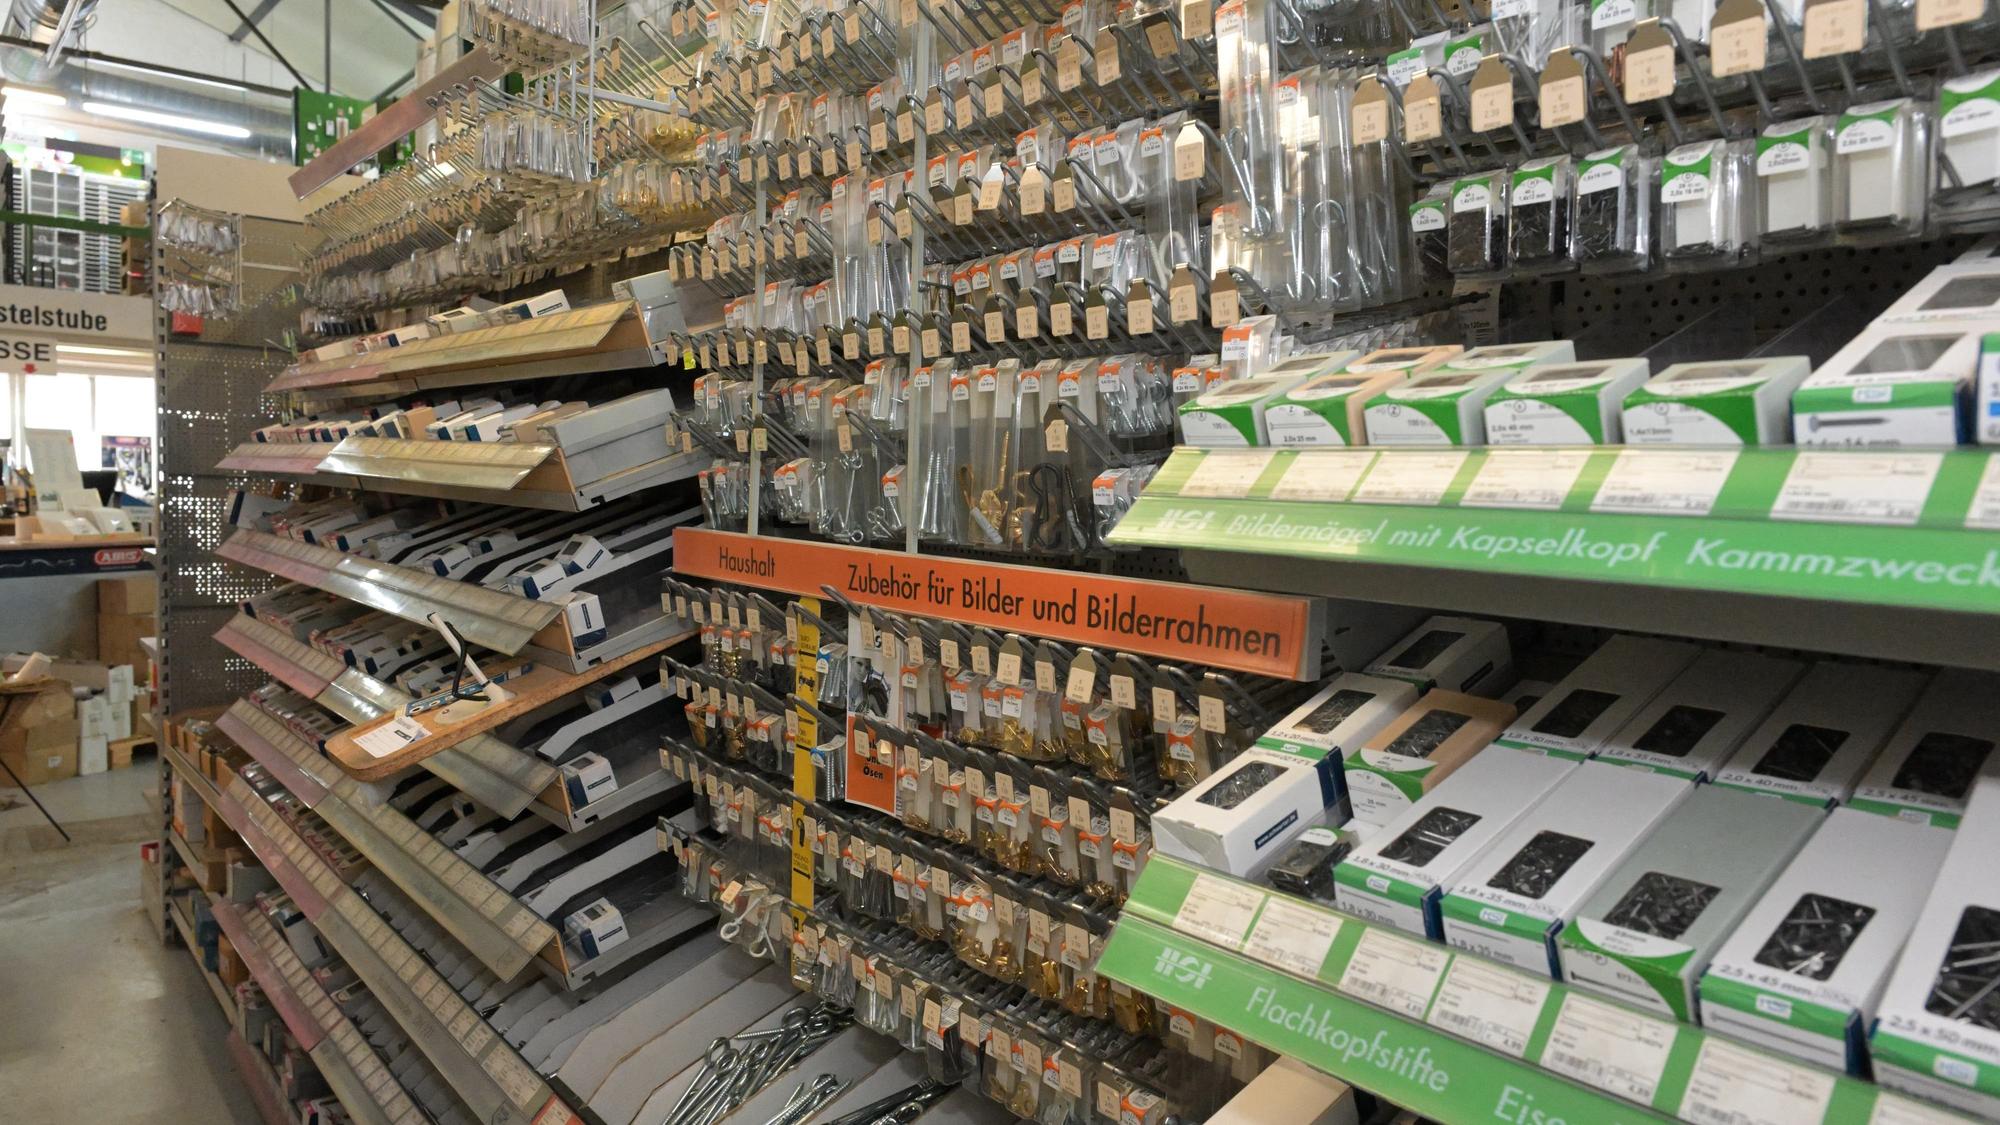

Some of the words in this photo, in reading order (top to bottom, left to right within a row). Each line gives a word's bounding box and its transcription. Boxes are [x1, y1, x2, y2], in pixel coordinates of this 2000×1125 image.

[0, 304, 107, 331] stelstube
[0, 340, 51, 361] SSE
[1226, 513, 1388, 547] Bildernägel
[1388, 522, 1442, 549] mit
[1447, 525, 1668, 568] Kapselkopf
[1686, 537, 2000, 587] Kammzweck
[718, 546, 776, 578] Haushalt
[848, 564, 921, 601] Zubehör
[927, 570, 955, 606] für
[962, 576, 1024, 616] Bilder
[1032, 587, 1077, 625] und
[1086, 591, 1281, 658] Bilderrahmen
[1246, 986, 1449, 1092] Flachkopfstifte
